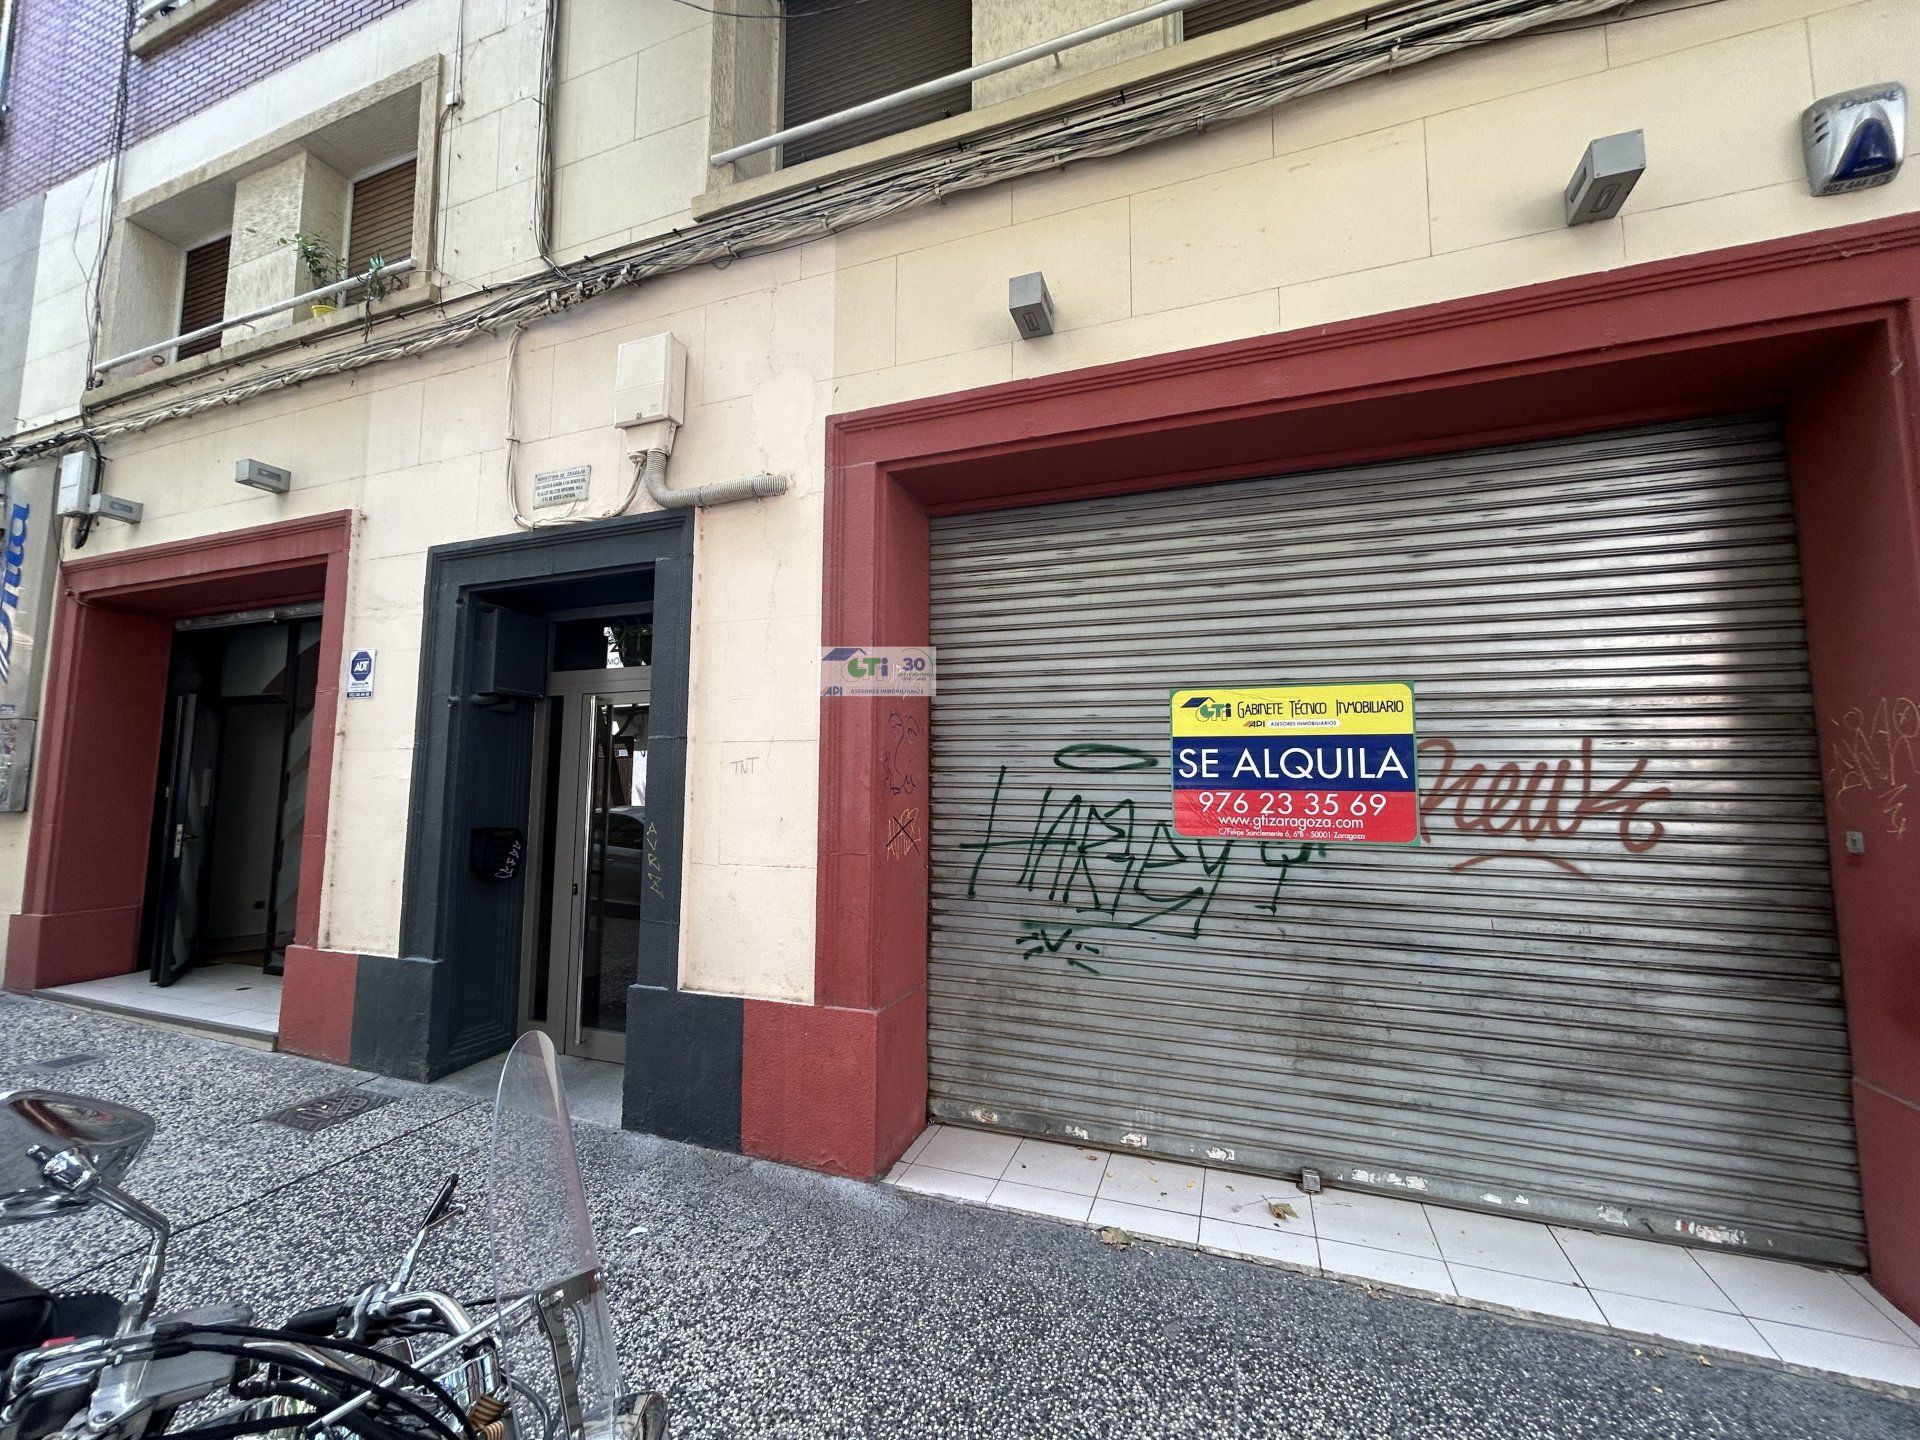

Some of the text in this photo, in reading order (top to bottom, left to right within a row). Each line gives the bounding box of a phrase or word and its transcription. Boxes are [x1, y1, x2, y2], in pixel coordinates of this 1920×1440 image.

[354, 660, 370, 672] ADT
[1297, 719, 1337, 727] INMOBILIARIOS
[731, 757, 759, 775] TNT
[1178, 746, 1409, 779] SE ALQUILA
[1198, 791, 1387, 817] 976 23 35 69
[1218, 813, 1364, 832] www.gtizaragoza.com
[1333, 832, 1366, 841] Zaragoza
